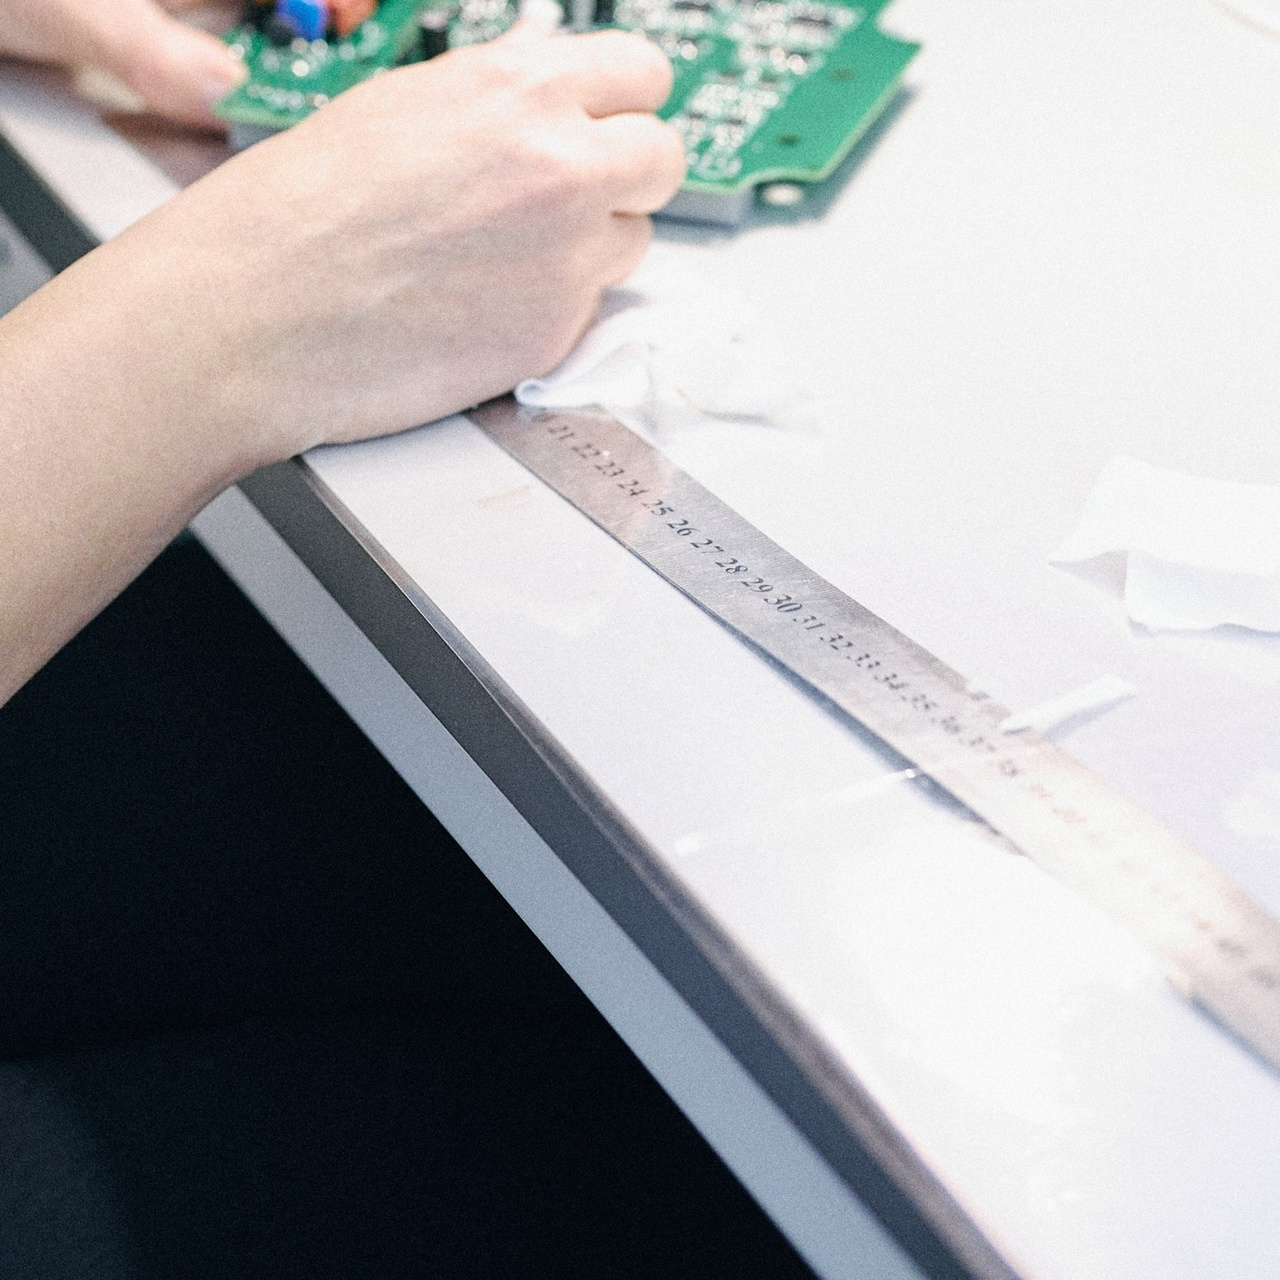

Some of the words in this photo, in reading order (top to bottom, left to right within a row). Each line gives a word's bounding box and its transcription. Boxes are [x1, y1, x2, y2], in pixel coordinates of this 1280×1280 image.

[594, 461, 625, 477] 23
[617, 479, 651, 496] 24
[641, 498, 675, 517] 25
[667, 518, 701, 537] 26
[690, 538, 725, 554] 27
[715, 557, 749, 575] 28
[740, 577, 774, 594] 29
[763, 594, 803, 613] 30
[792, 614, 826, 631] 31
[819, 634, 854, 651] 32
[845, 653, 881, 669] 33
